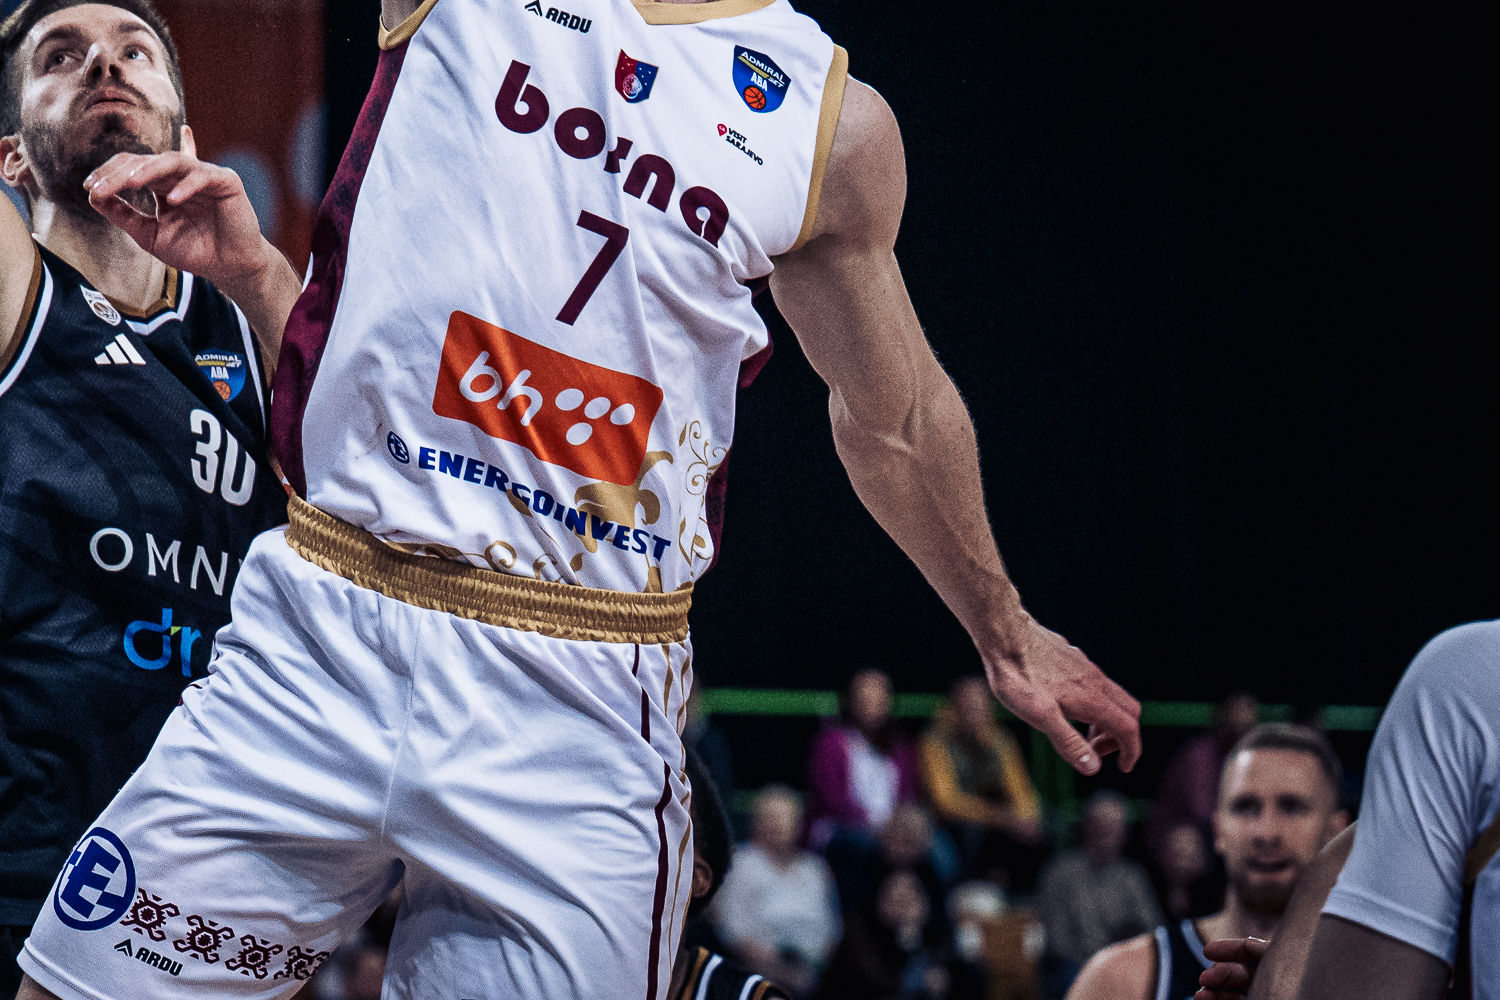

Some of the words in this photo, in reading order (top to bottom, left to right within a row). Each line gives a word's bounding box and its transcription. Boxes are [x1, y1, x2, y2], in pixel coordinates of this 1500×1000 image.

[545, 6, 593, 34] ARDU
[740, 51, 785, 85] ADMIRAL
[750, 71, 768, 92] ABA
[725, 135, 764, 166] SARAJEVO
[728, 127, 748, 143] VISIT
[554, 209, 630, 327] 7
[194, 353, 239, 361] ADMIRAL
[210, 365, 230, 380] ABA
[190, 408, 256, 506] 30
[418, 446, 672, 562] ENERGOINVEST
[88, 527, 243, 597] OMN
[134, 946, 184, 977] ARDU
